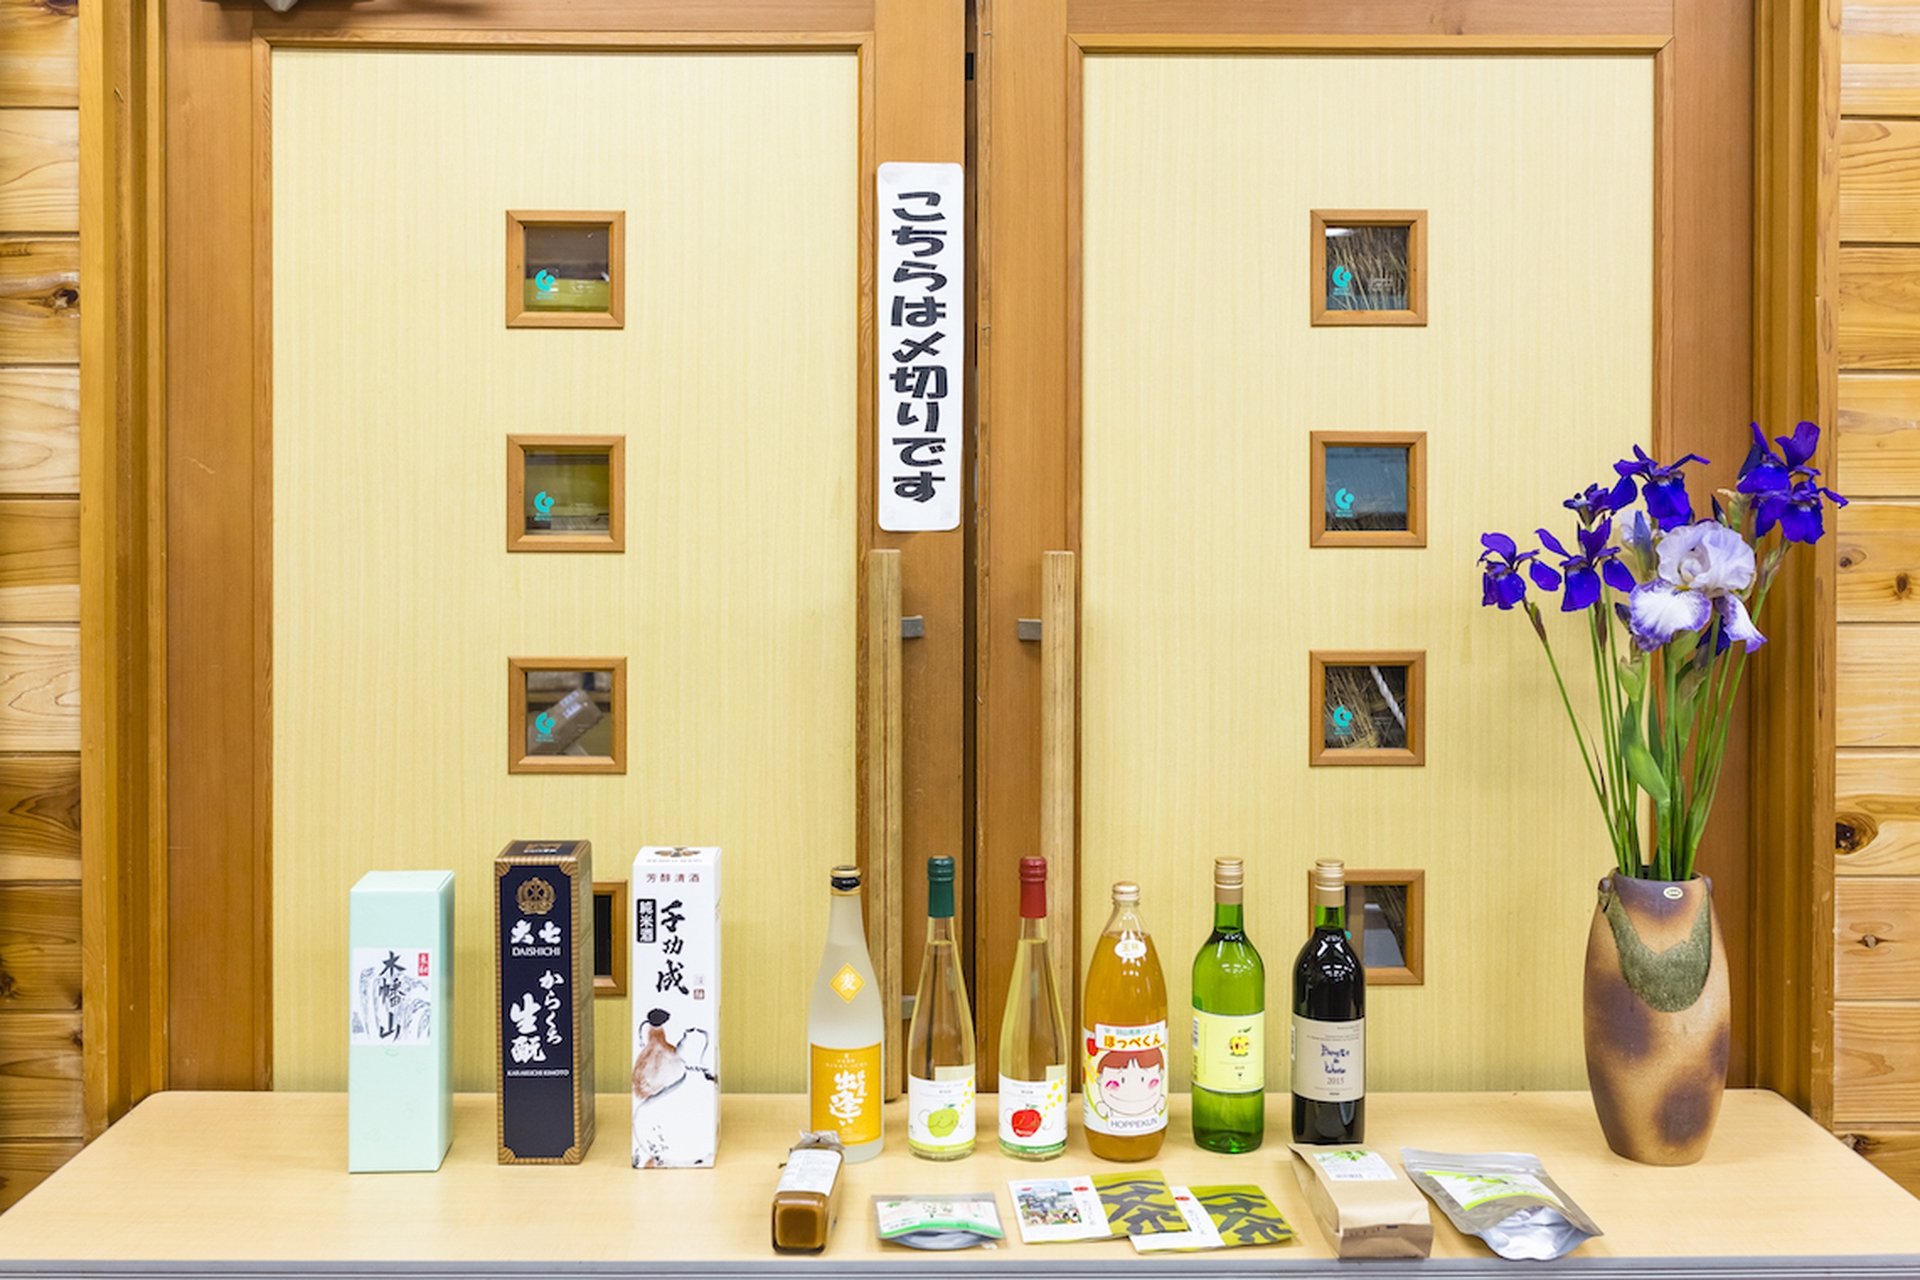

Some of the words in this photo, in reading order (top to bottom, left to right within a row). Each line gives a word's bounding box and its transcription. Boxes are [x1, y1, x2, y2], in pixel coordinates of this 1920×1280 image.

[510, 919, 562, 945] 大七
[511, 946, 561, 956] DAISHICHI
[1104, 1033, 1162, 1049] ほっぺくん
[543, 1069, 570, 1077] KIMOTO
[1327, 1077, 1345, 1086] 2015
[1110, 1117, 1158, 1130] HOPPEKUN
